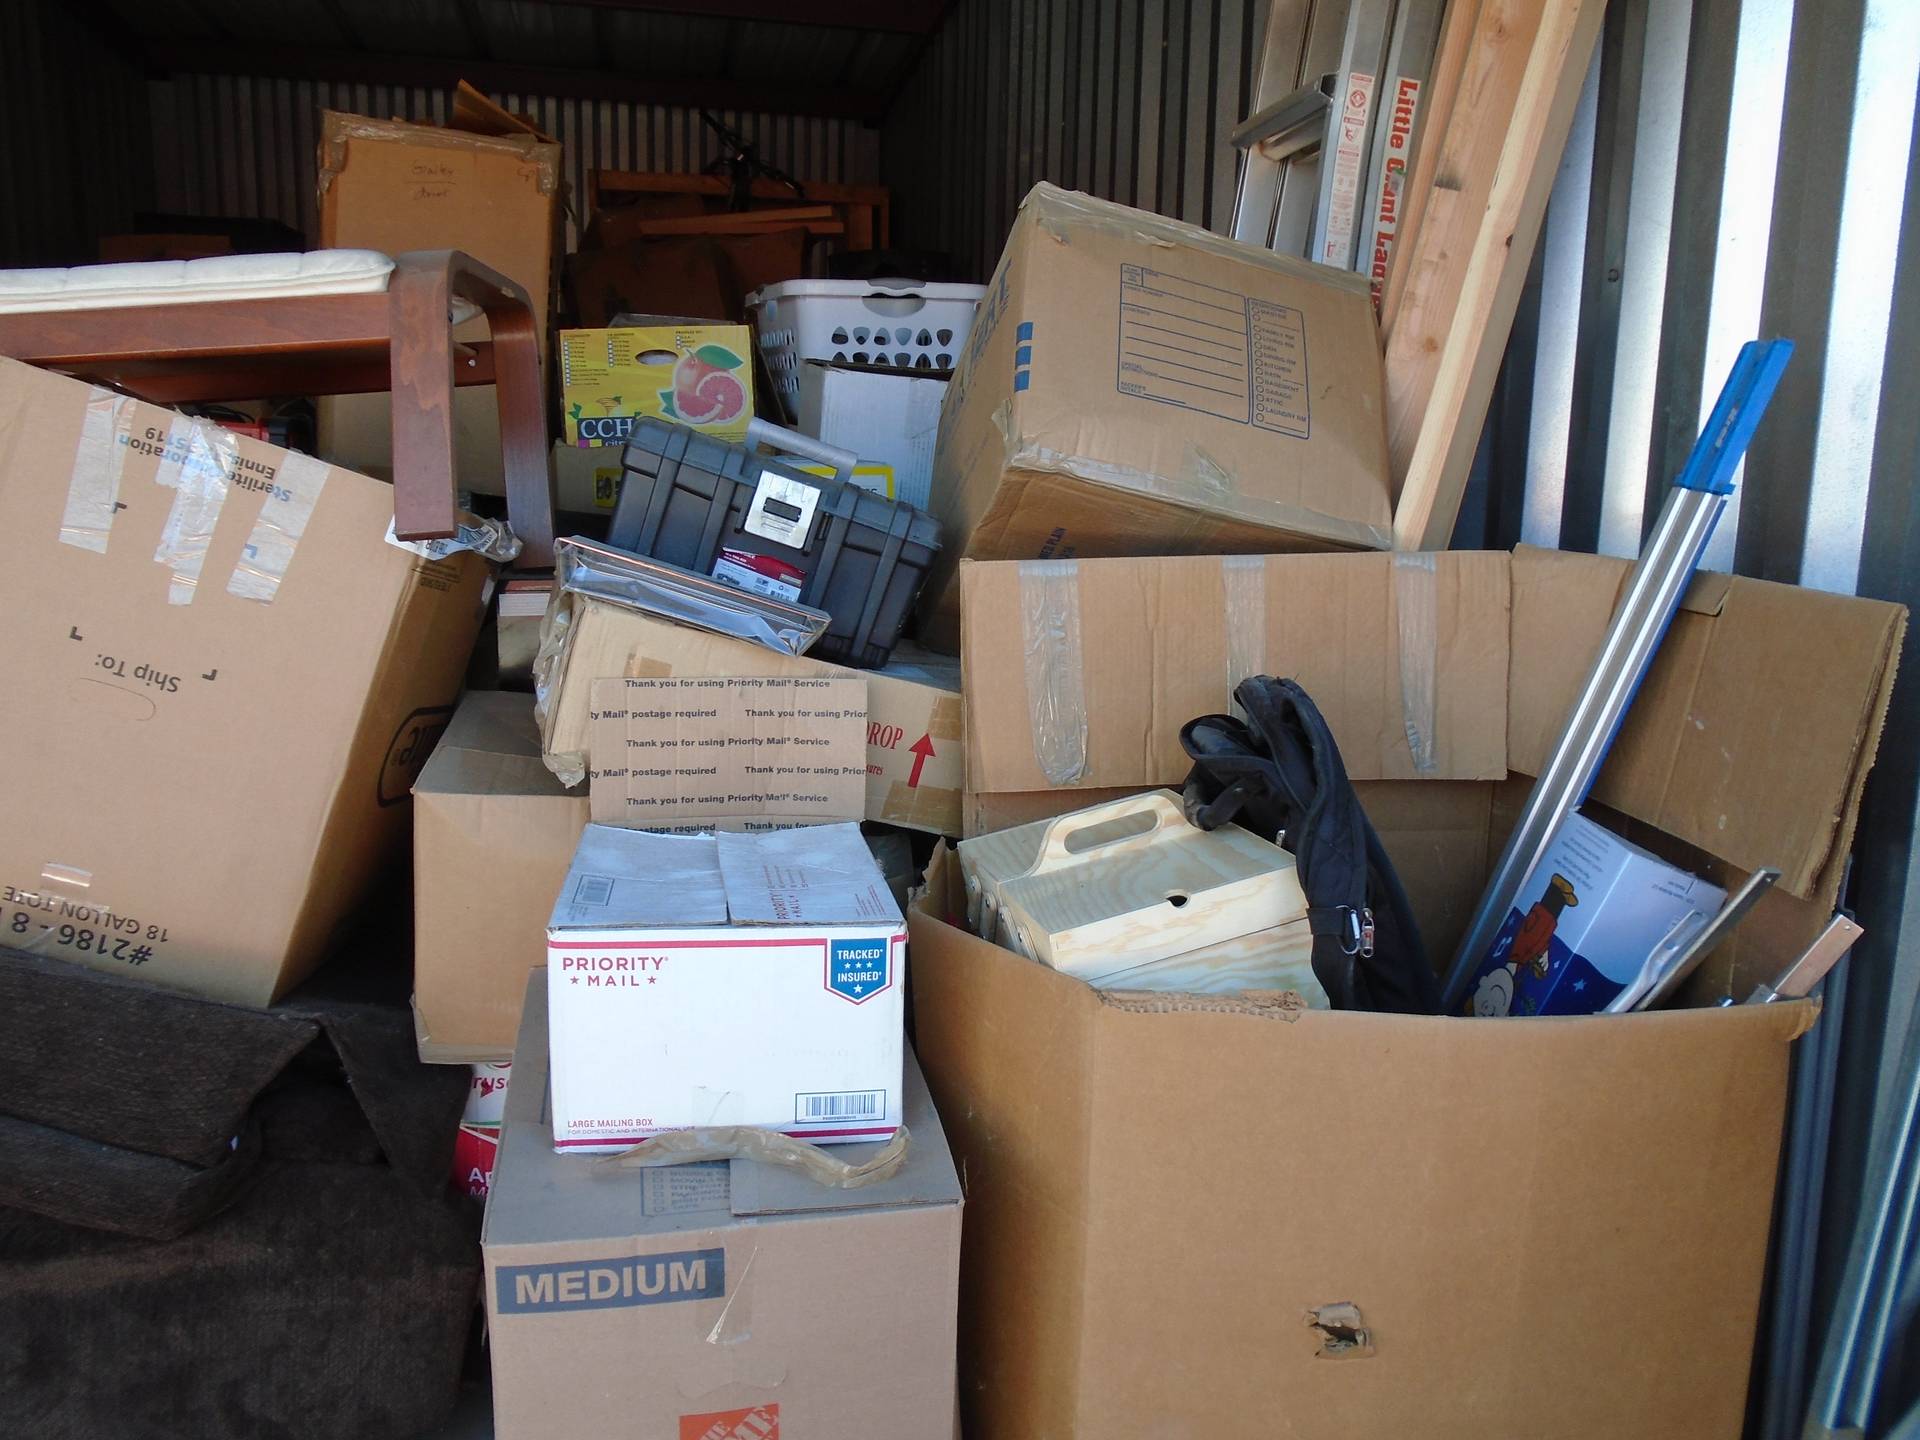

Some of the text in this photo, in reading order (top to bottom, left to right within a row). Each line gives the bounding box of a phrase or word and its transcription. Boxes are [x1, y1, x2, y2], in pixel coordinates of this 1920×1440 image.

[1390, 78, 1418, 150] Little
[226, 470, 293, 503] Sterilite
[94, 654, 182, 693] Ship To:
[625, 679, 656, 688] Thank
[659, 680, 677, 689] you
[680, 679, 694, 688] for
[697, 680, 725, 689] using
[727, 679, 763, 688] Priority
[794, 679, 831, 688] Service
[631, 710, 672, 719] postage
[674, 709, 717, 718] required
[745, 709, 775, 718] Thank
[777, 710, 795, 719] you
[797, 709, 812, 718] for
[814, 709, 841, 719] using
[867, 721, 904, 750] ROP
[626, 739, 657, 748] Thank
[660, 740, 678, 749] you
[680, 739, 696, 747] for
[698, 738, 725, 748] using
[728, 737, 764, 746] Priority
[793, 737, 830, 746] Service
[632, 768, 672, 778] postage
[674, 766, 717, 776] required
[744, 766, 774, 774] Thank
[776, 766, 794, 775] you
[796, 766, 811, 774] for
[813, 766, 840, 776] using
[626, 797, 657, 806] Thank
[660, 797, 678, 807] you
[680, 796, 696, 805] for
[698, 795, 725, 805] using
[728, 794, 764, 803] Priority
[792, 793, 829, 803] Service
[674, 823, 716, 832] required
[744, 822, 773, 830] Thank
[775, 823, 793, 831] you
[2, 885, 54, 912] TOTE
[11, 911, 30, 934] 8
[59, 901, 169, 943] 18 GALLON
[57, 923, 153, 966] #2186
[837, 948, 881, 960] TRACKED
[562, 956, 665, 972] PRIORITY
[587, 974, 640, 987] MAIL
[837, 970, 880, 982] INSURED
[567, 1118, 653, 1128] LARGE MAILING BOX
[515, 1260, 708, 1304] MEDIUM
